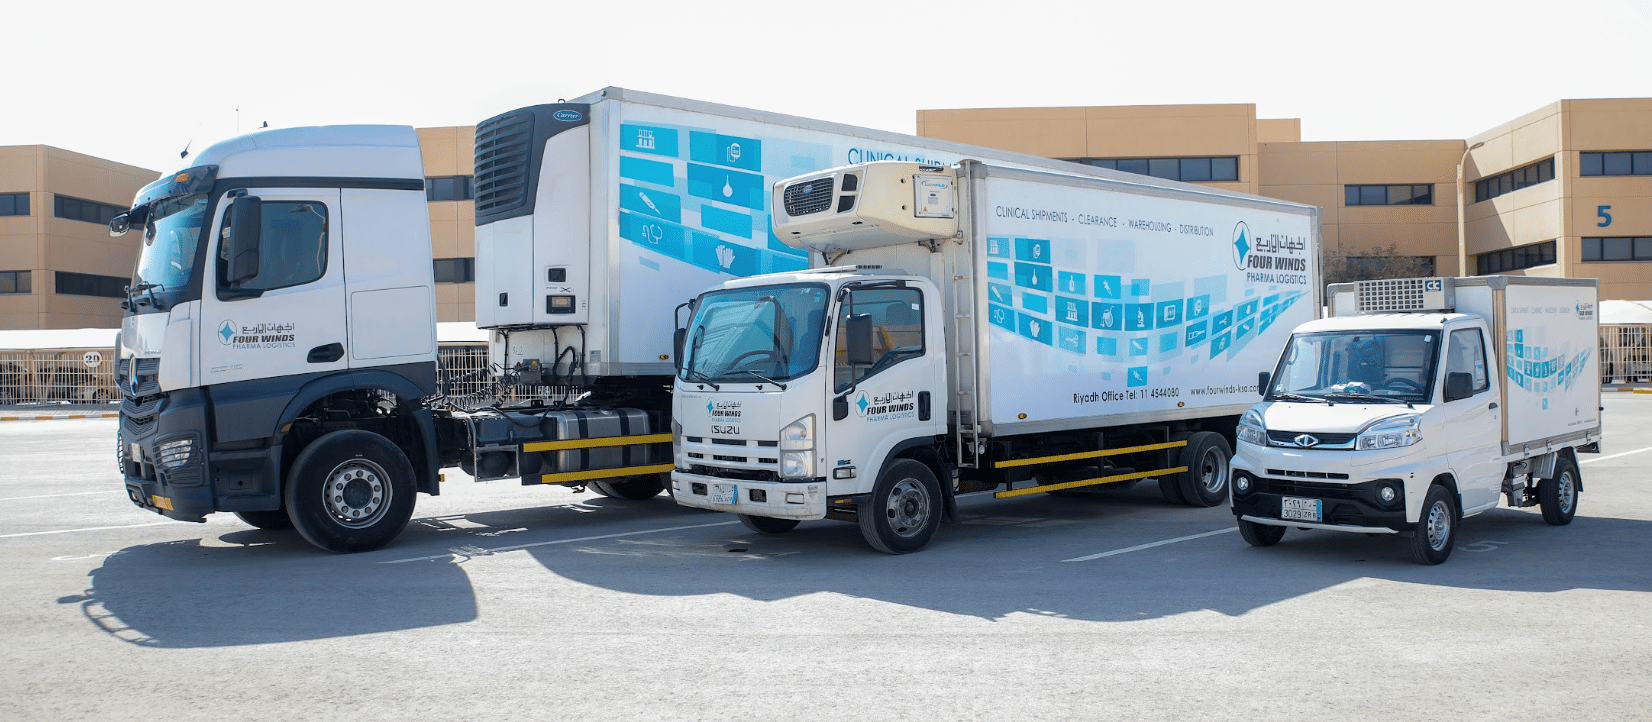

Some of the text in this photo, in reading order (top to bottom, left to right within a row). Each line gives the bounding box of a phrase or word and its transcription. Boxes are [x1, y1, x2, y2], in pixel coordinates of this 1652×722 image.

[996, 205, 1030, 220] CLINICAL
[1031, 208, 1068, 223] SHIPMENTS
[1078, 213, 1117, 228] CLEARANCE
[1128, 219, 1172, 233] WAREHOUSING
[1179, 224, 1214, 237] DISTRIBUTION
[1597, 205, 1612, 228] 5
[1247, 254, 1306, 272] FOUR WINDS
[1246, 271, 1307, 285] PHARMA LOGISTICS
[232, 334, 295, 344] FOUR WINDS
[1073, 387, 1180, 405] Riyadh Office Tel: 11 4544080
[867, 402, 914, 416] FOUR WINDS
[866, 411, 914, 423] PHARMA LOGISTICS
[711, 425, 740, 435] ISUZU
[1283, 509, 1302, 519] 3029
